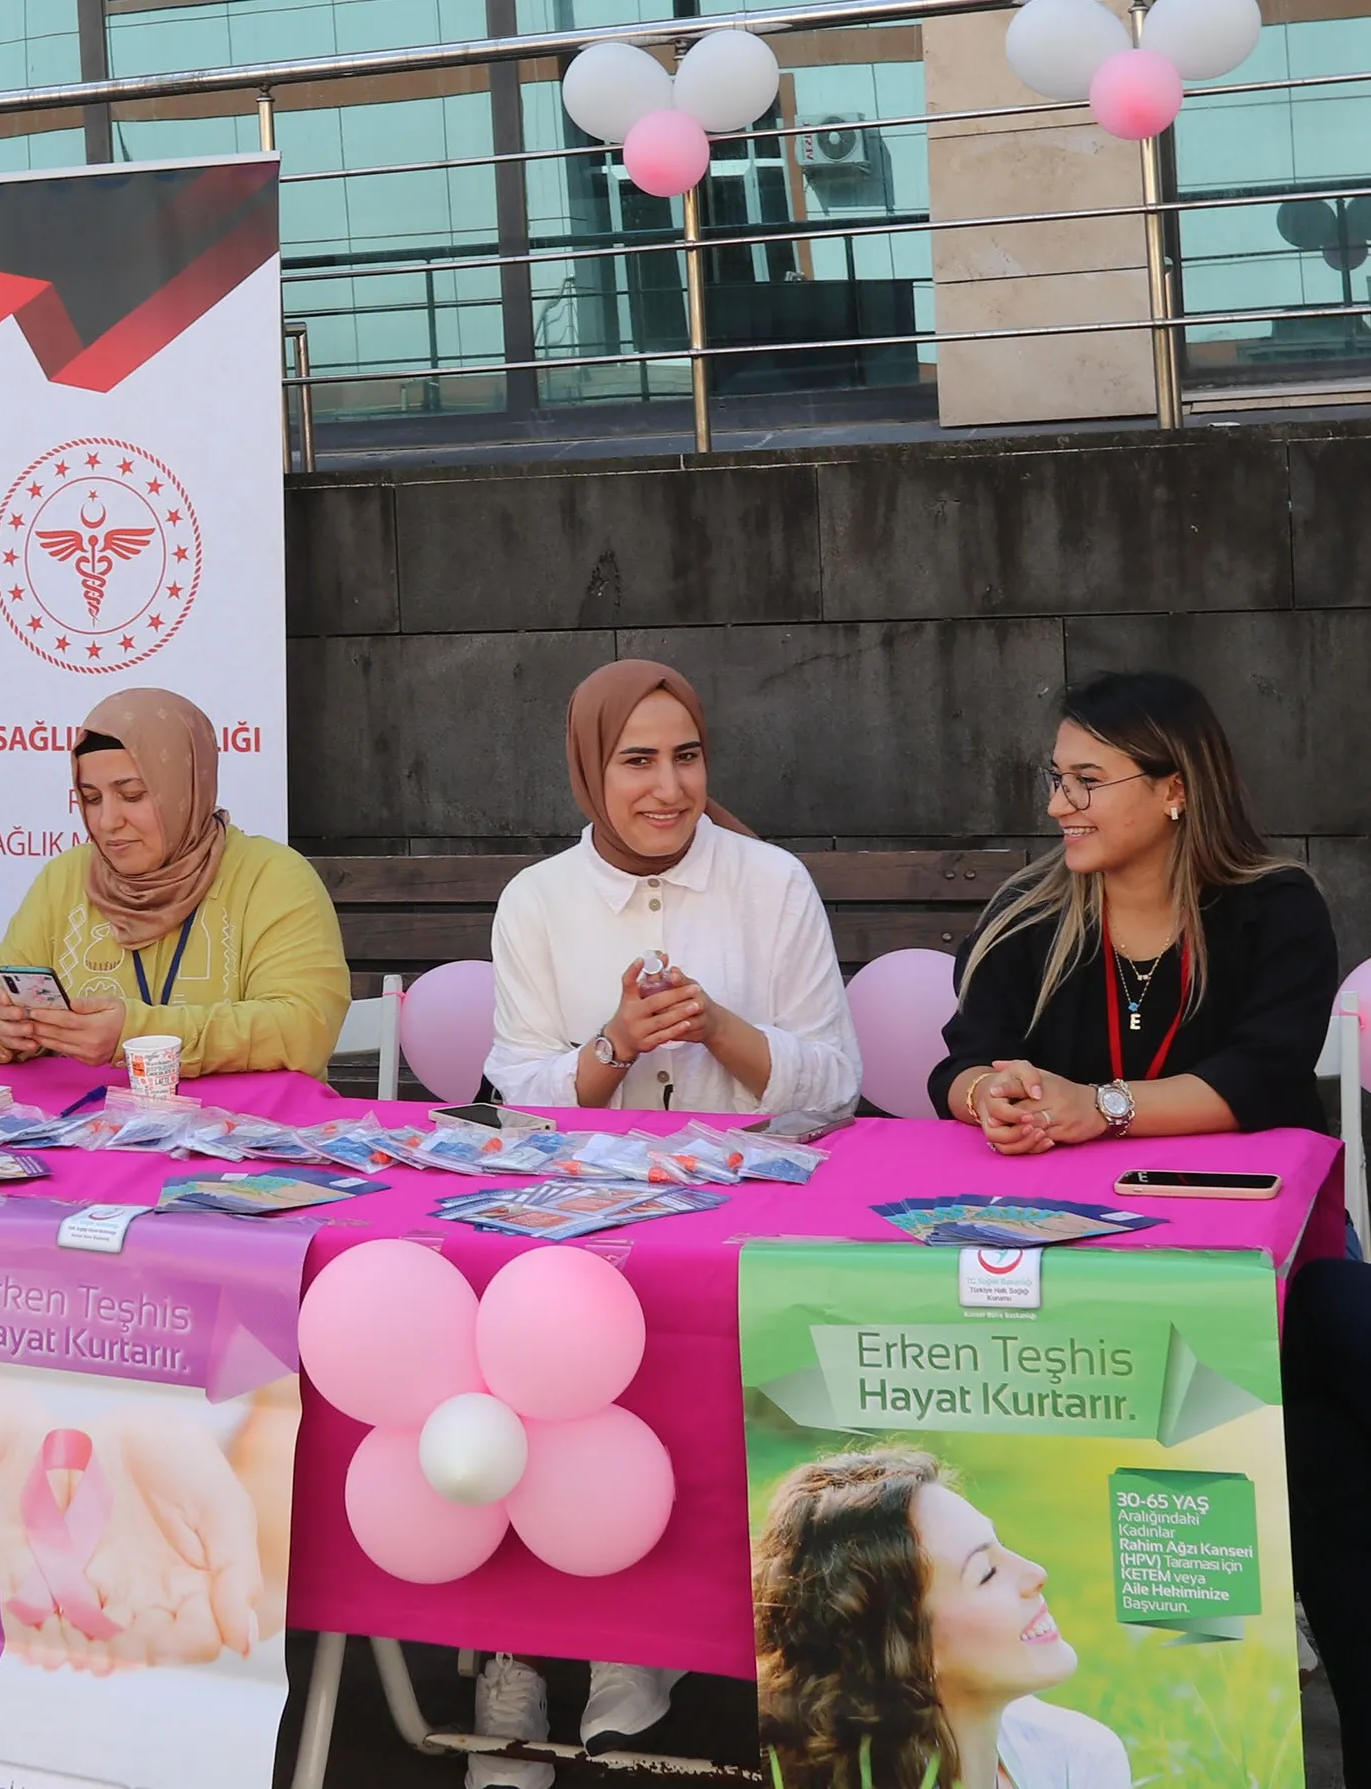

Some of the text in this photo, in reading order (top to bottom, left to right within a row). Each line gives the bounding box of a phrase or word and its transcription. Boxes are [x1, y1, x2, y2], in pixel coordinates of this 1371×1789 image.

[78, 1284, 191, 1332] Teşhis
[65, 1326, 189, 1371] Kurtarır.
[857, 1331, 1134, 1385] Erken Teşhis
[859, 1378, 1136, 1421] Hayat Kurtarır.
[1117, 1492, 1209, 1515] 30-65 YAŞ
[1118, 1509, 1199, 1526] Aralığındaki
[1119, 1524, 1175, 1538] Kadınlar
[1120, 1538, 1253, 1558] Rahim Ağzı Kanseri
[1120, 1553, 1242, 1574] (HPV) Taraması için
[1122, 1568, 1206, 1586] KETEM veya
[1122, 1583, 1229, 1601] Aile Hekiminize
[1123, 1597, 1190, 1613] Başvurun.
